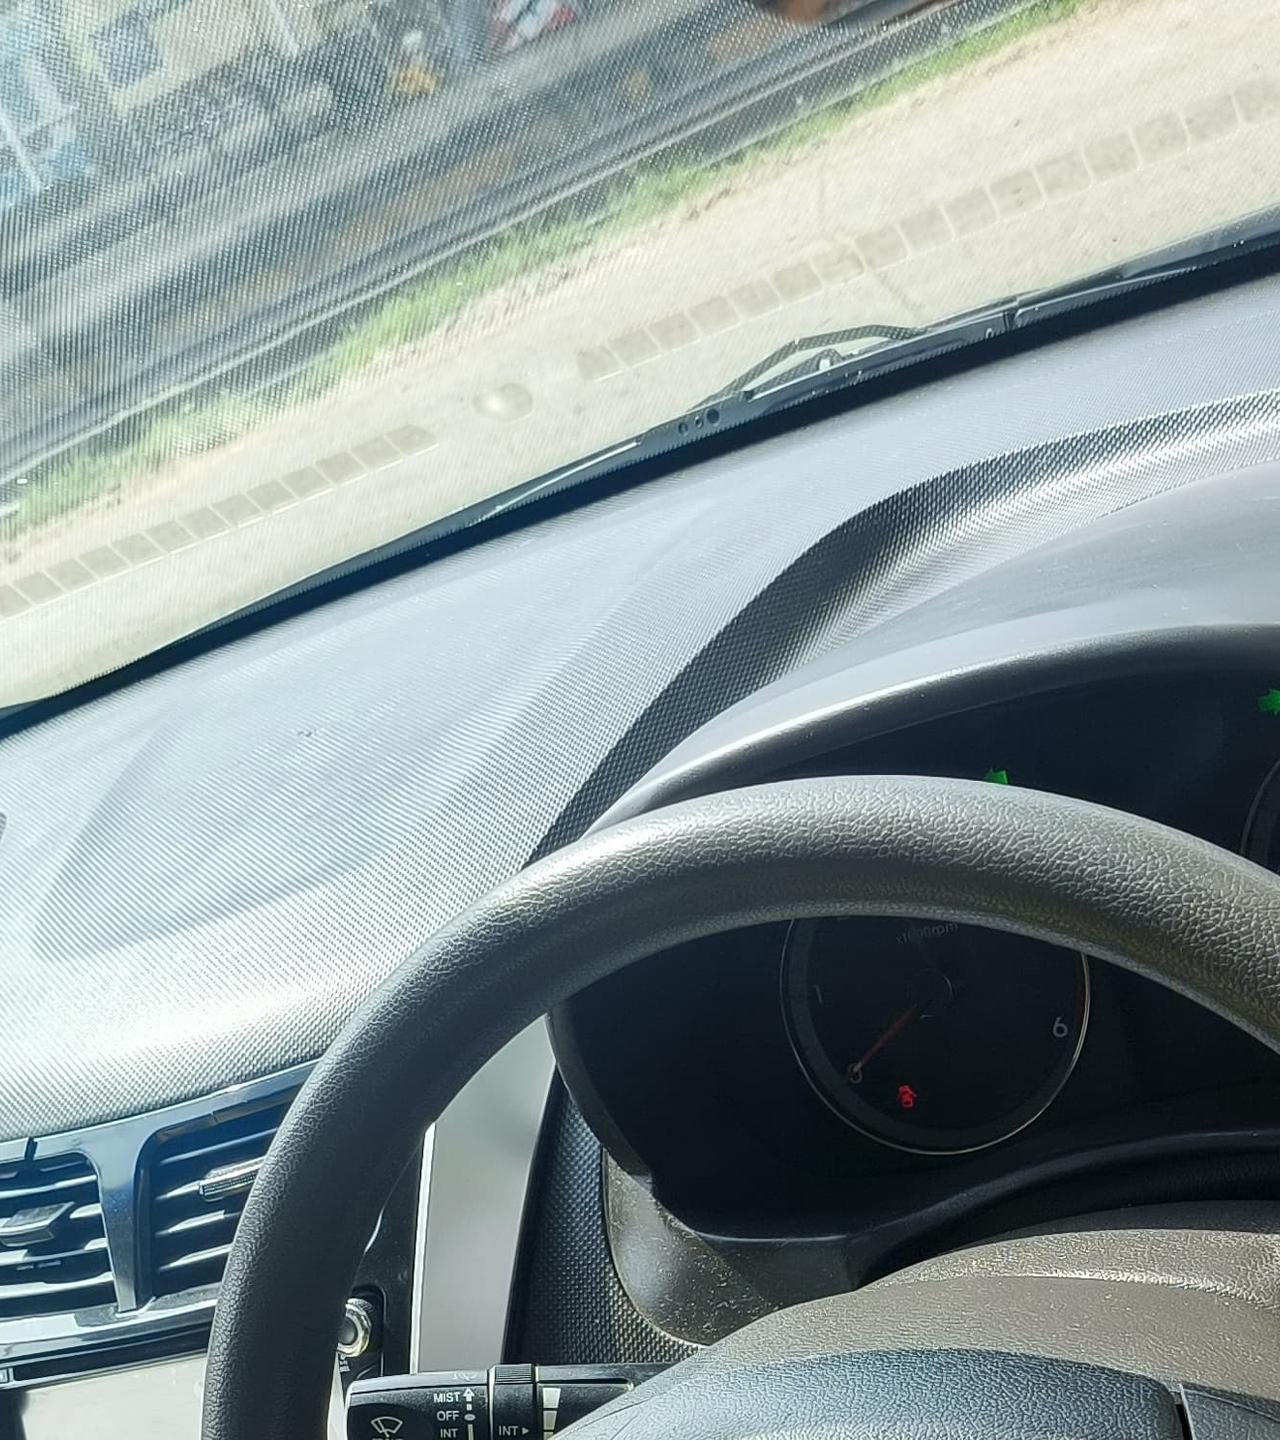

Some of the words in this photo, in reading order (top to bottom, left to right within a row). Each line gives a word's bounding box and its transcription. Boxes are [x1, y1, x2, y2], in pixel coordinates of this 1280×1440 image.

[1052, 1016, 1069, 1038] 6
[433, 1391, 461, 1403] MIST
[437, 1410, 460, 1421] OFF
[440, 1428, 459, 1439] INT
[498, 1425, 518, 1437] INT
